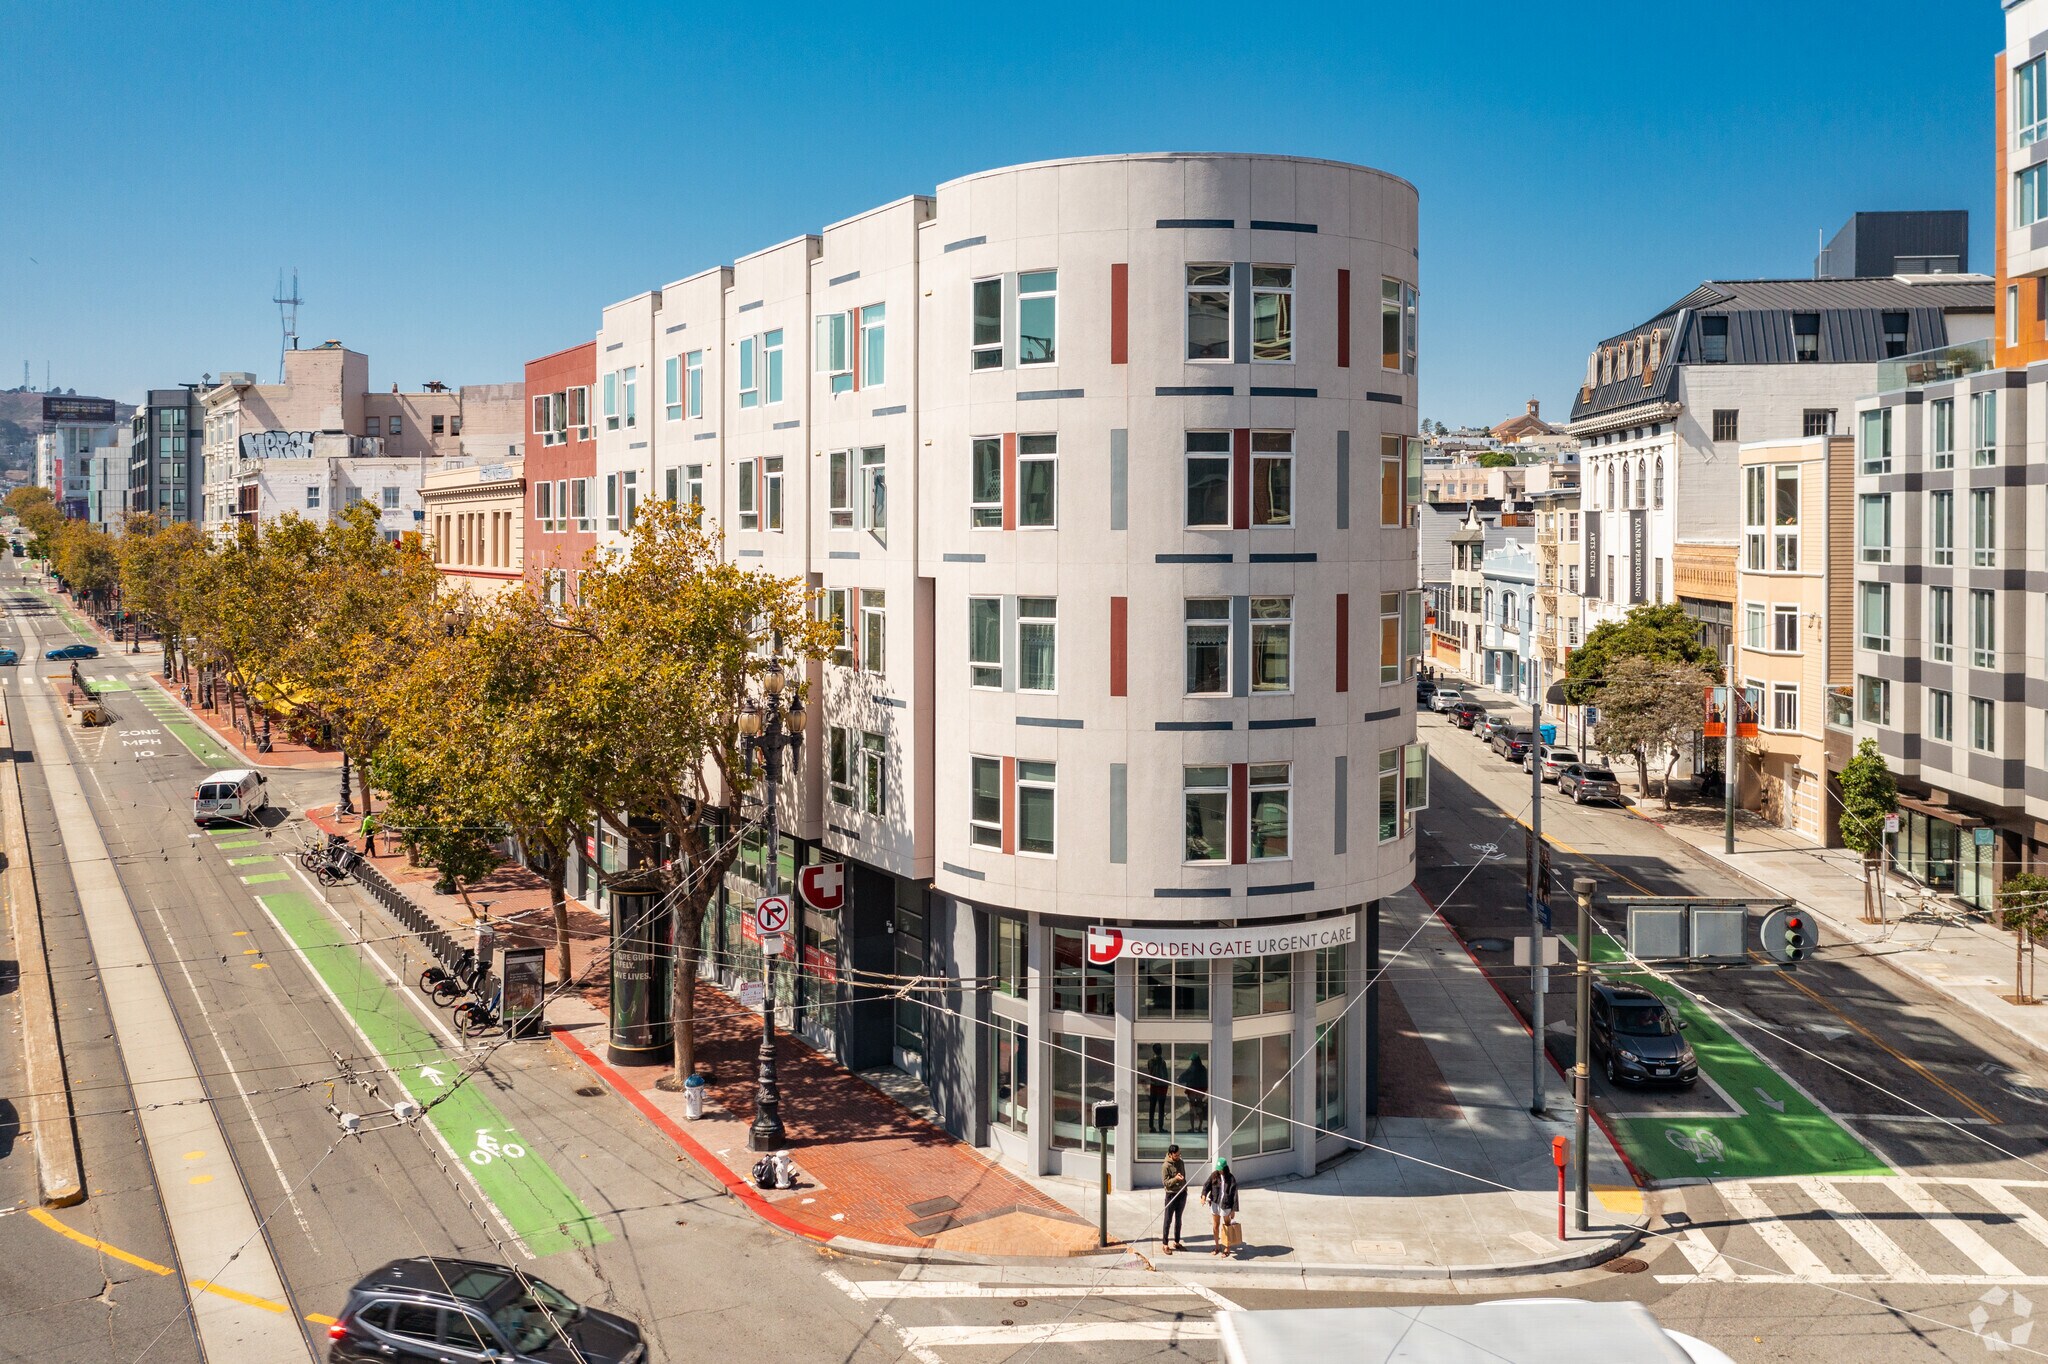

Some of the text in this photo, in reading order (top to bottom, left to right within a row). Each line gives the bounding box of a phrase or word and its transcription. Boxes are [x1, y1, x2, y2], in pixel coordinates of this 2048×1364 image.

[118, 729, 161, 737] ZONE
[121, 738, 162, 746] MPH
[134, 750, 155, 758] 10
[1130, 926, 1352, 957] GOLDEN GATE URGENT CARE
[628, 972, 652, 981] LIVES.
